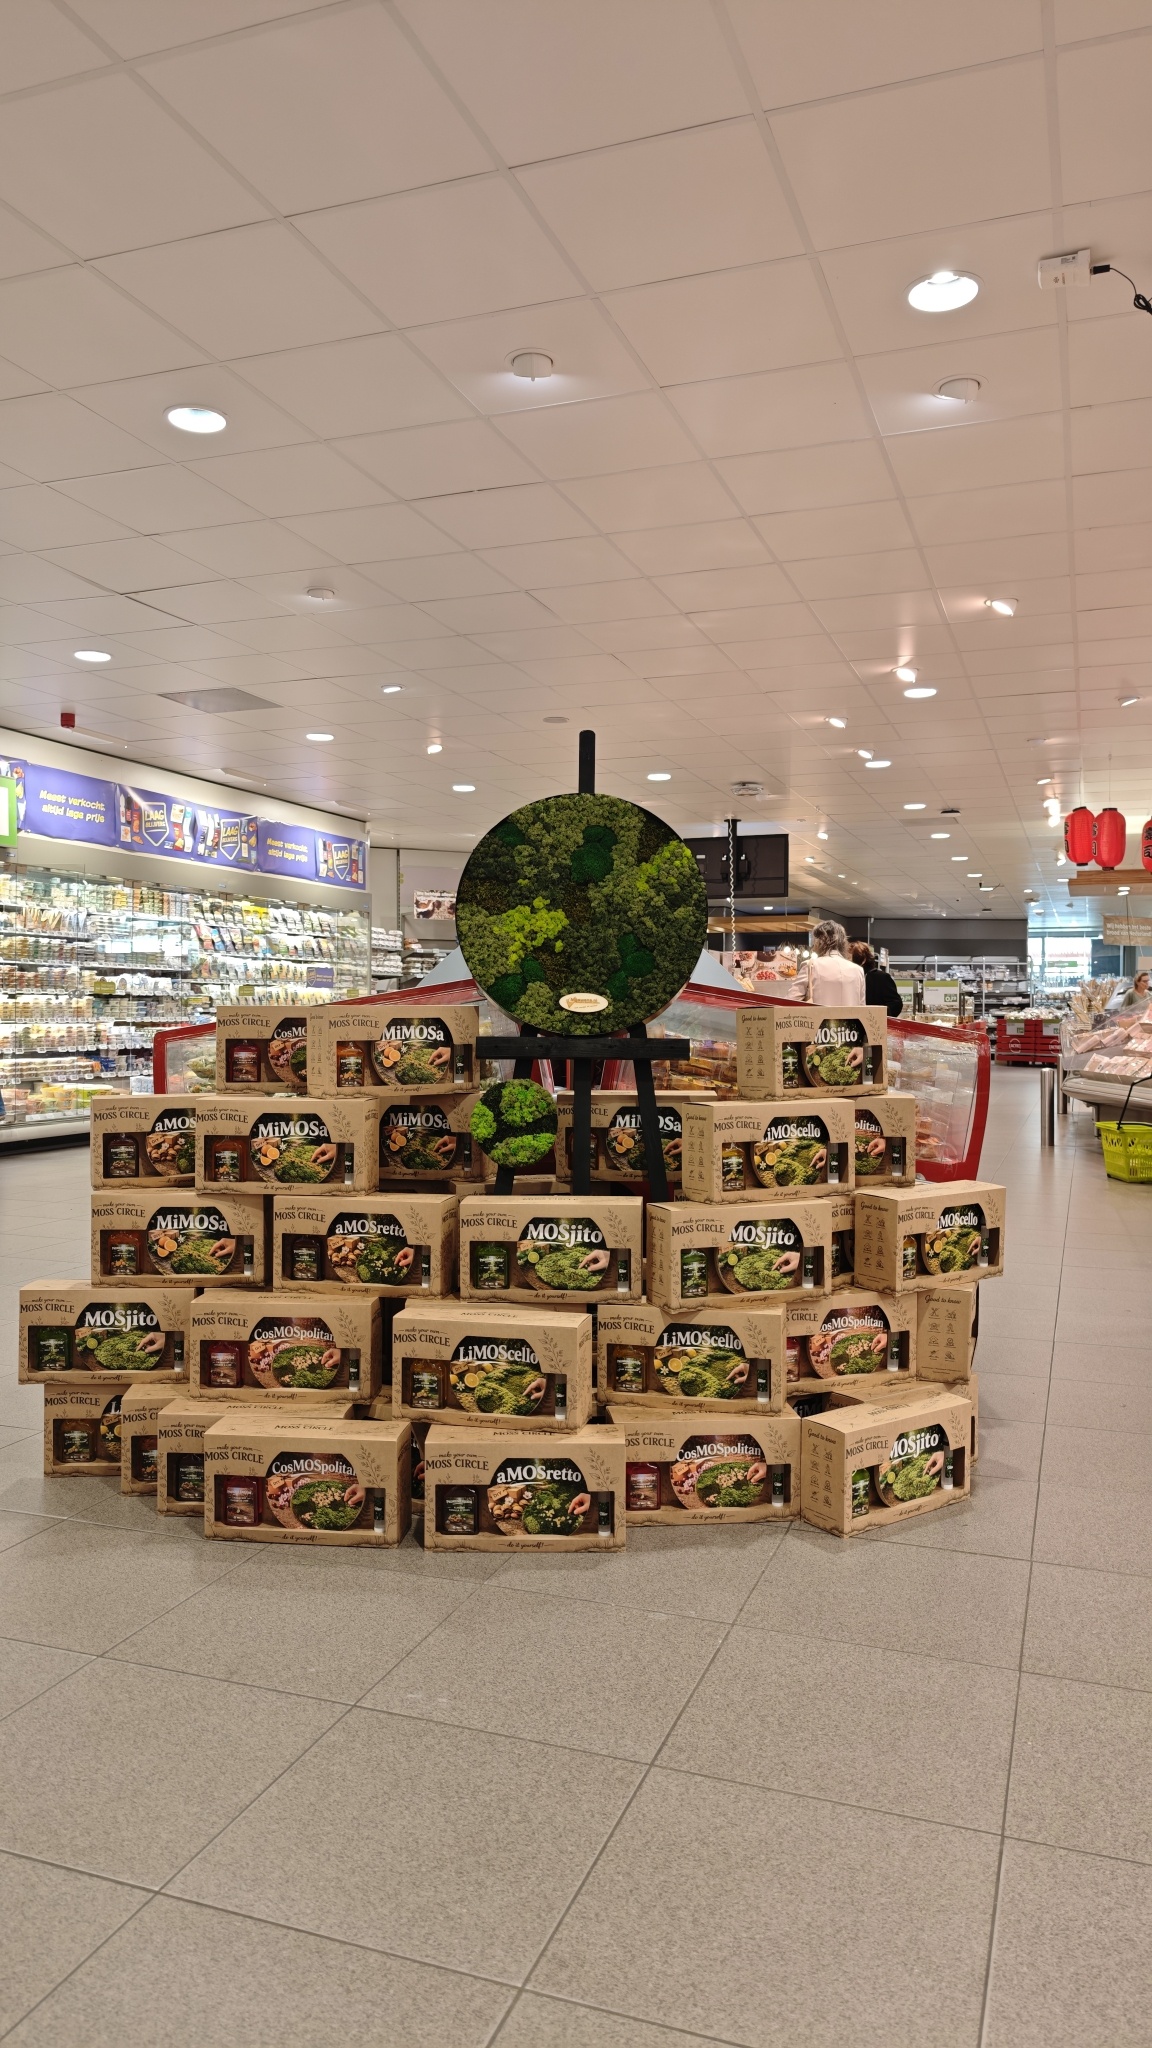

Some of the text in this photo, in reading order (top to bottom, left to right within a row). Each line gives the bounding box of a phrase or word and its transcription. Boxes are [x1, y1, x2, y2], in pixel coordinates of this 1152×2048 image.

[40, 789, 66, 804] Meest
[41, 803, 105, 824] altijd lage prijs
[144, 809, 165, 821] LAAG
[222, 826, 239, 837] LAAG
[283, 851, 295, 860] lage
[334, 849, 349, 860] LAAG
[217, 1018, 271, 1029] MOSS CIRCLE
[328, 1019, 380, 1029] MOSS CIRCLE
[775, 1020, 814, 1030] MOSS CIRCLE
[381, 1025, 445, 1042] MiMOSa
[94, 1111, 150, 1122] MOSS CIRCLE
[558, 1107, 574, 1116] MOS
[196, 1113, 249, 1124] MOSS CIRCLE
[389, 1112, 451, 1130] MiMOSa
[258, 1120, 329, 1139] MiMOSa
[714, 1121, 762, 1132] MOSS CIRCLE
[860, 1202, 872, 1211] Good
[92, 1208, 146, 1218] MOSS CIRCLE
[274, 1211, 326, 1223] MOSS CIRCLE
[898, 1212, 935, 1224] MOSS CIRCLE
[156, 1214, 228, 1232] MiMOSa
[461, 1217, 518, 1229] MOSS CIRCLE
[936, 1210, 978, 1230] iMOScello
[335, 1219, 407, 1237] aMOSretto
[672, 1224, 725, 1237] MOSS CIRCLE
[526, 1223, 603, 1248] MOSjito
[728, 1225, 795, 1250] MOSjito
[924, 1294, 940, 1304] Good
[20, 1304, 75, 1314] MOSS CIRCLE
[85, 1310, 158, 1332] MOSjito
[192, 1317, 248, 1328] MOSS CIRCLE
[792, 1313, 819, 1322] CIRCLE
[598, 1321, 654, 1334] MOSS CIRCLE
[819, 1316, 884, 1332] osMOSpolitan
[393, 1333, 450, 1347] MOSS CIRCLE
[662, 1330, 742, 1350] LiMOScello
[458, 1344, 539, 1365] LiMOScello
[44, 1397, 100, 1407] MOSS CIRCLE
[123, 1413, 148, 1423] MOSS
[158, 1429, 183, 1439] MOSS
[807, 1428, 819, 1439] Good
[625, 1437, 675, 1448] OSS CIRCLE
[439, 1451, 452, 1459] make
[676, 1442, 761, 1462] CosMOSpolitan
[845, 1439, 889, 1460] MOSS CIRCLE
[204, 1451, 264, 1464] MOSS CIRCLE
[426, 1458, 489, 1471] MOSS CIRCLE
[496, 1465, 582, 1483] aMOSretto
